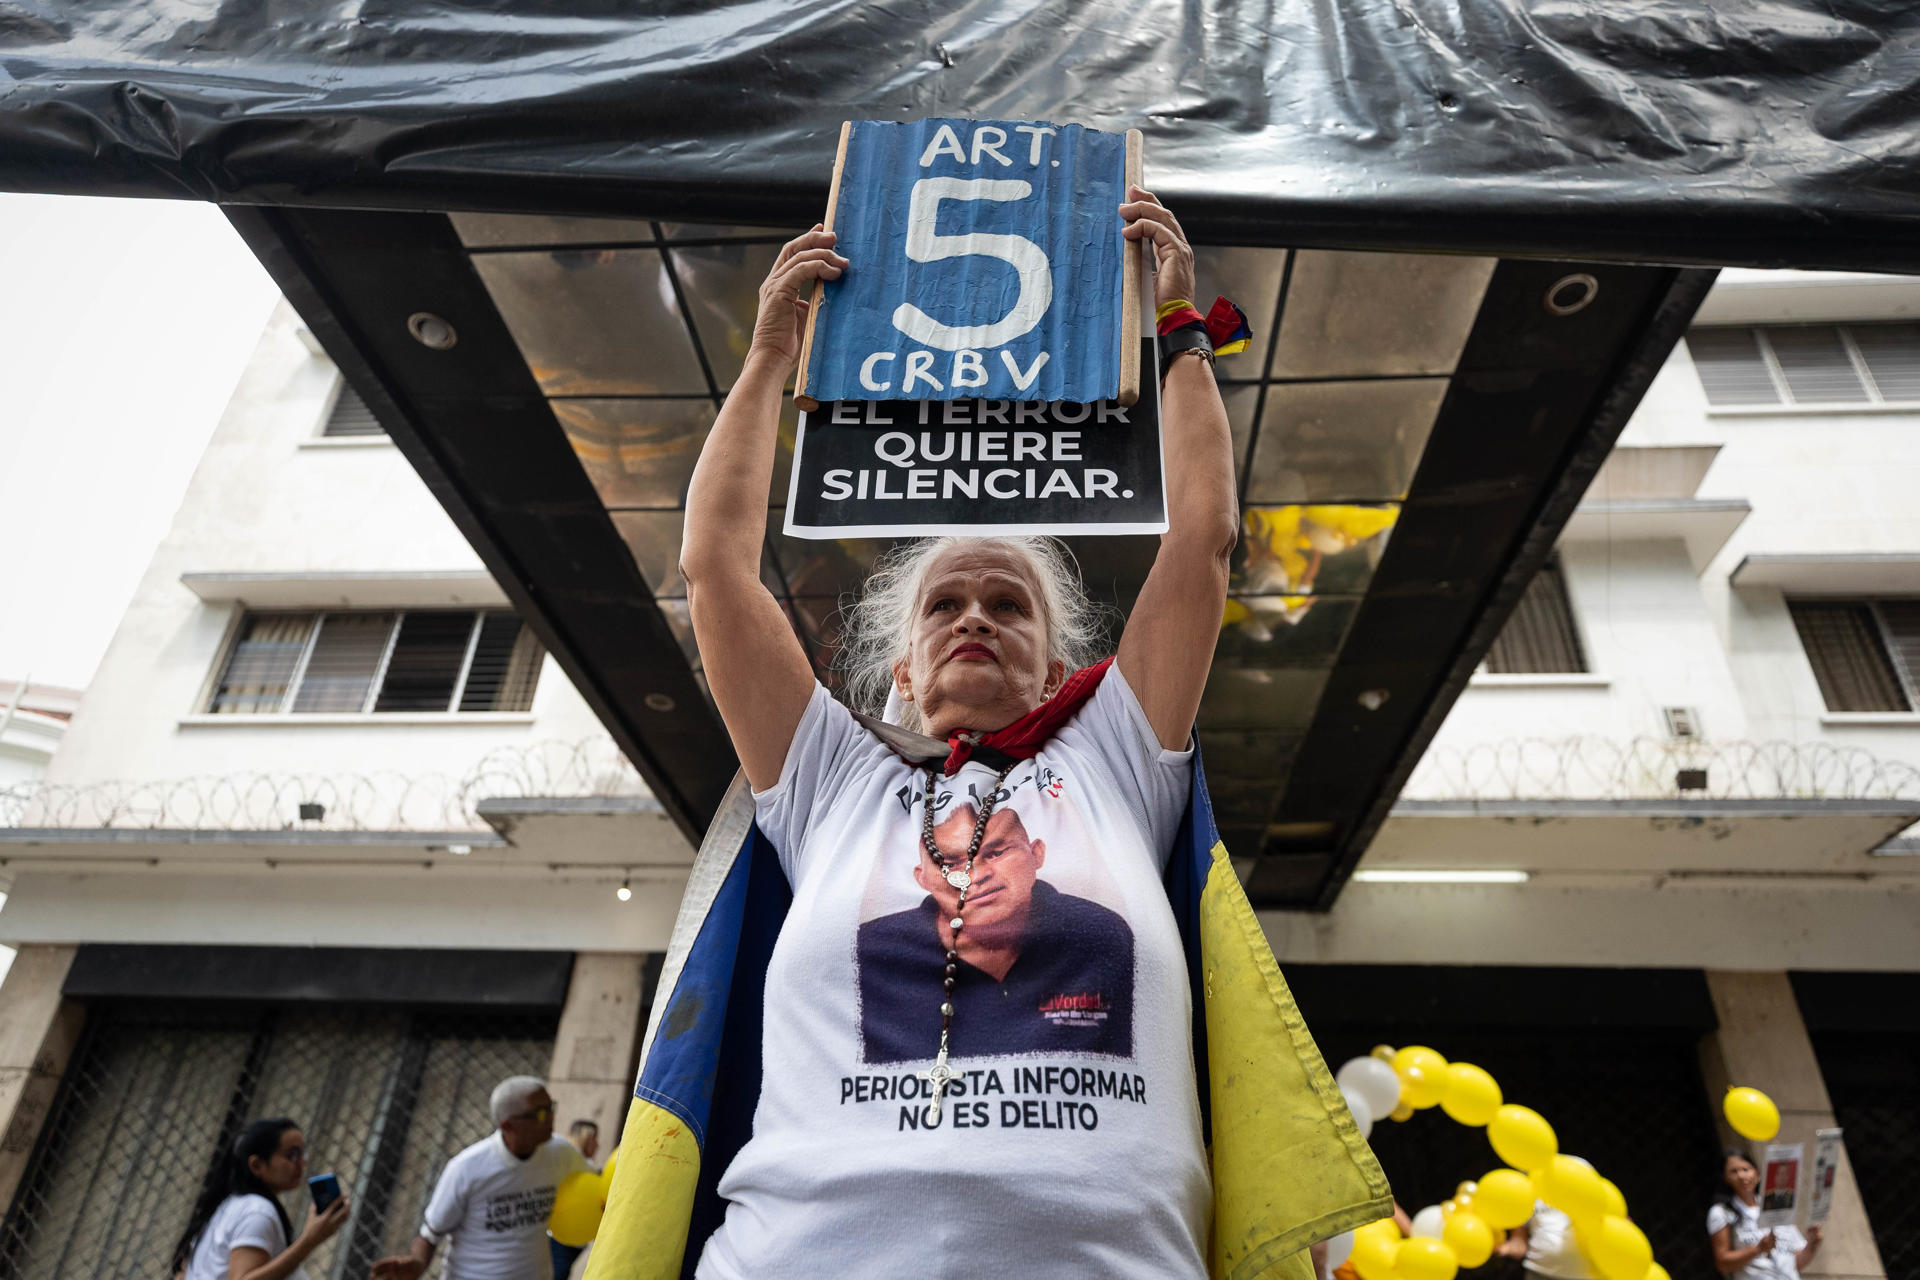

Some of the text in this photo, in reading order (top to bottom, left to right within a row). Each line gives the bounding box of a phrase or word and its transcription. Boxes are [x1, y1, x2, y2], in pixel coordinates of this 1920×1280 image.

[919, 124, 1061, 168] ART.
[892, 177, 1053, 352] 5
[859, 350, 1050, 394] CRBV
[831, 400, 1131, 425] EL TERROR
[874, 431, 1083, 468] QUIERE
[821, 468, 1135, 501] SILENCIAR.
[1014, 1067, 1147, 1105] INFORMAR
[899, 1100, 1099, 1131] NO ES DELITO
